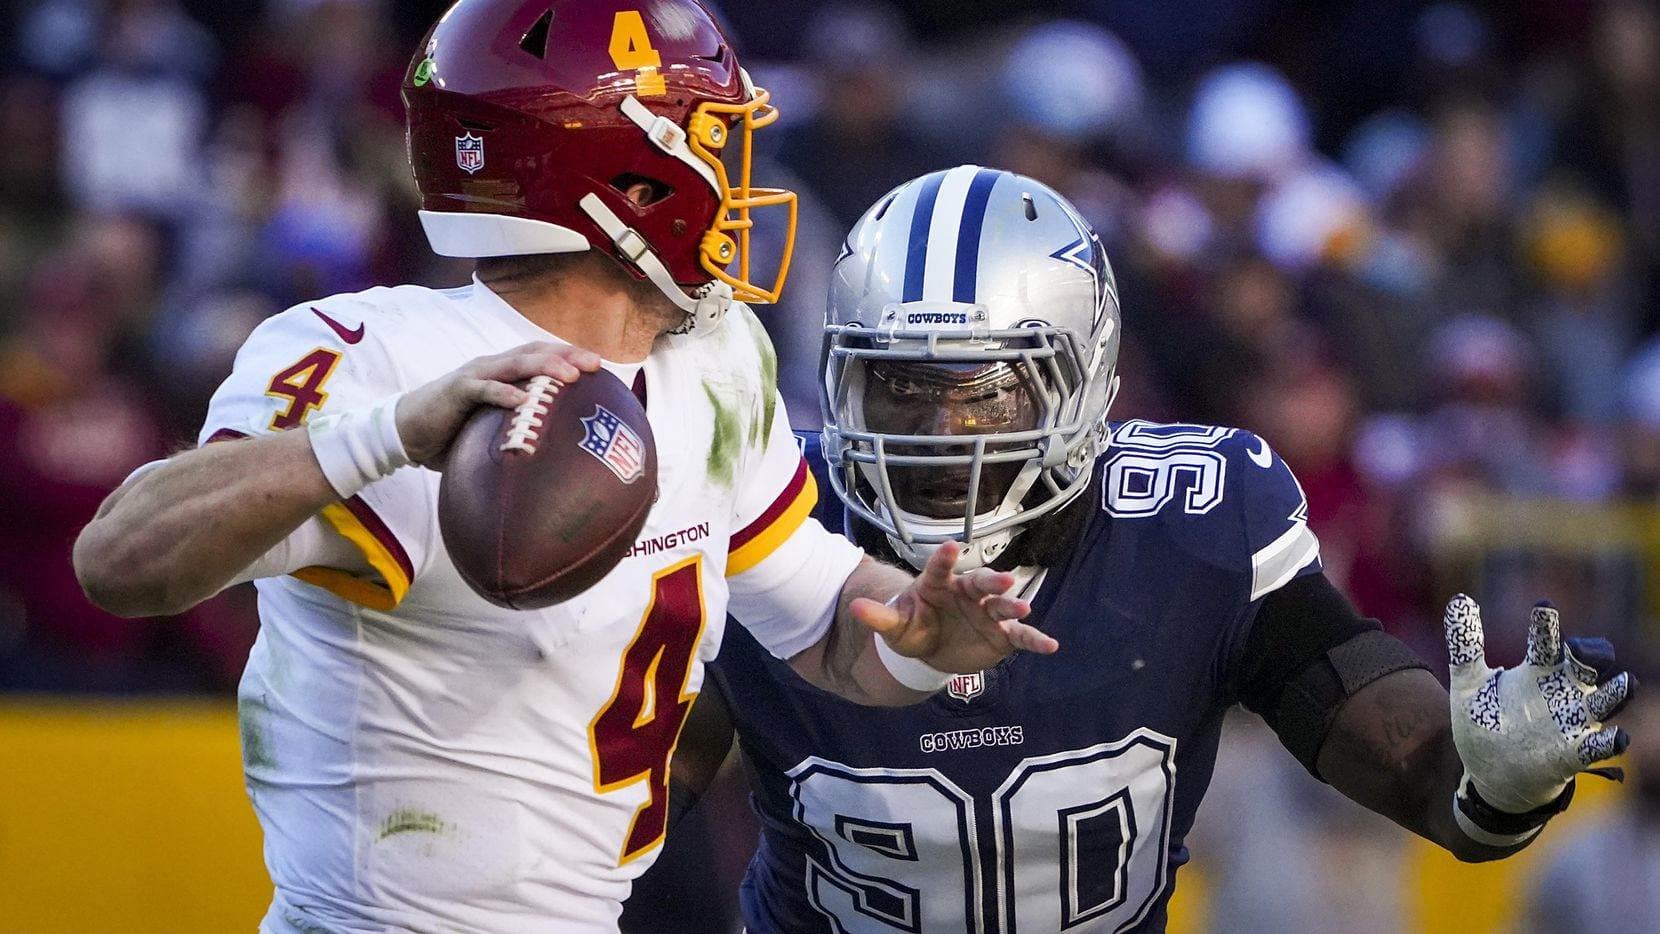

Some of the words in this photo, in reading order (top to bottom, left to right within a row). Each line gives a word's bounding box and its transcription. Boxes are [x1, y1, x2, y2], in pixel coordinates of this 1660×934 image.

[608, 10, 667, 96] 4
[460, 151, 481, 167] NFL
[907, 312, 966, 324] COWBOYS
[264, 346, 343, 432] 4
[607, 429, 641, 476] NFL
[949, 675, 980, 694] NFL
[587, 554, 707, 867] 4
[920, 725, 1024, 753] COWBOYS
[784, 727, 1178, 934] 90
